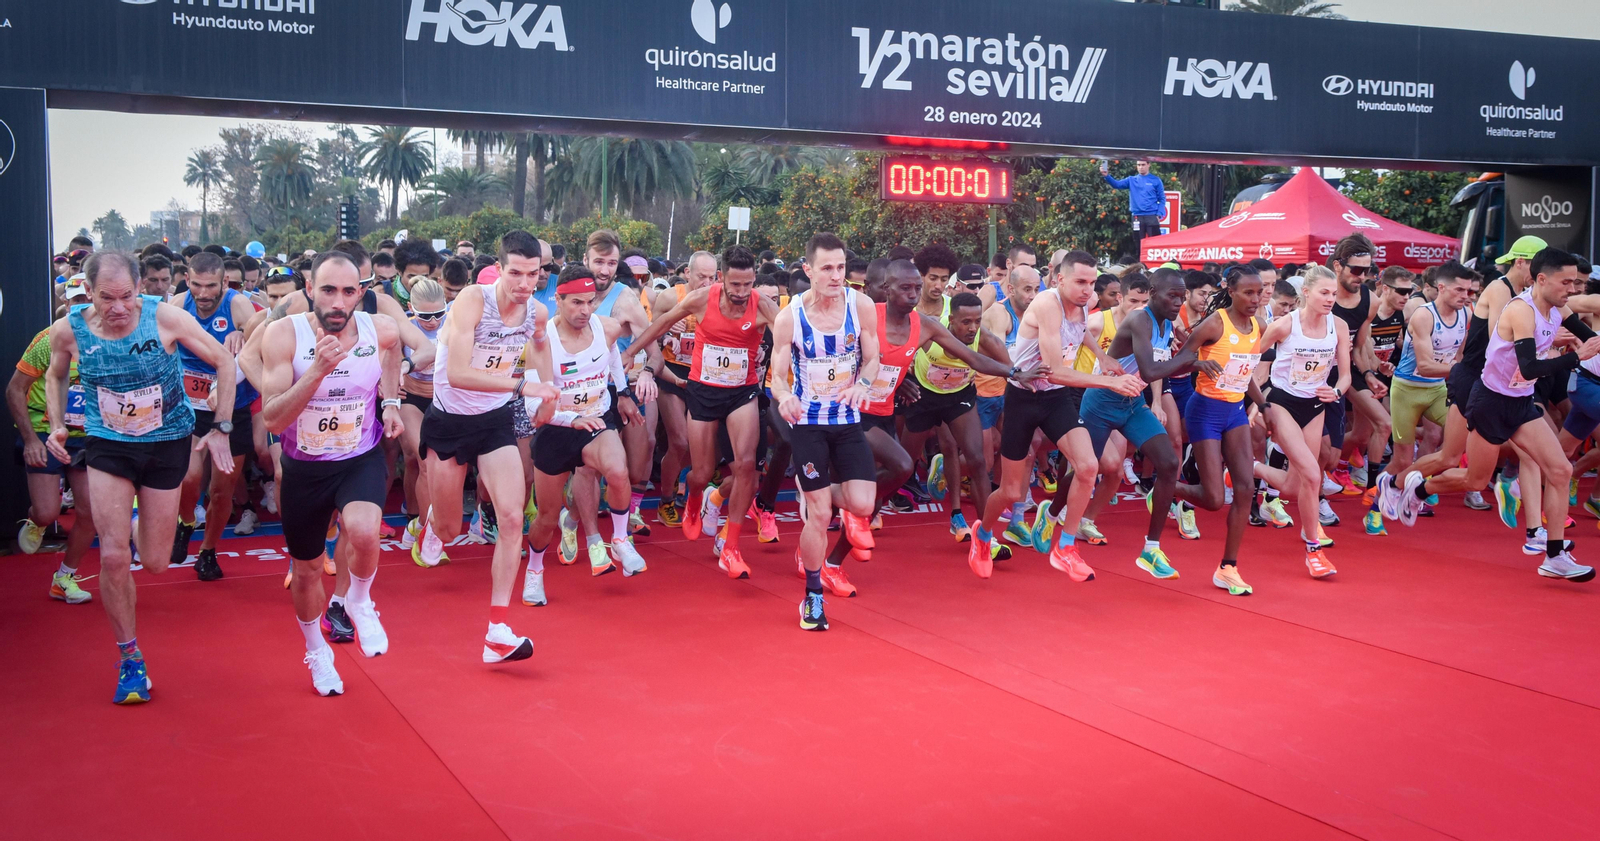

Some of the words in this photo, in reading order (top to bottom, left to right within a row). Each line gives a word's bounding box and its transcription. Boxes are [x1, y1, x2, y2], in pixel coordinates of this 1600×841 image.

[172, 12, 264, 31] Hyundauto
[268, 20, 315, 35] Motor
[405, 0, 569, 51] HOKA
[645, 46, 776, 72] quirónsalud
[901, 31, 1069, 71] maratón
[656, 76, 719, 92] Healthcare
[723, 80, 766, 95] Partner
[946, 65, 1073, 102] sevilla
[1164, 56, 1274, 100] HOKA
[1357, 79, 1434, 99] HYUNDAI
[1356, 100, 1405, 114] Hyundauto
[1407, 103, 1434, 114] Motor
[1480, 101, 1563, 122] quirónsalud
[924, 106, 945, 122] 28
[949, 110, 998, 126] enero
[1001, 110, 1042, 128] 2024
[1486, 126, 1526, 138] Healthcare
[1528, 128, 1557, 139] Partner
[890, 164, 1008, 198] 00:00:01
[485, 355, 502, 368] 51
[716, 355, 730, 368] 10
[1238, 363, 1250, 375] 15
[1305, 361, 1320, 371] 67
[828, 368, 836, 381] 8
[944, 372, 950, 380] 7
[573, 392, 589, 405] 54
[117, 401, 137, 417] 72
[339, 403, 358, 412] SEVILLA
[318, 416, 339, 432] 66
